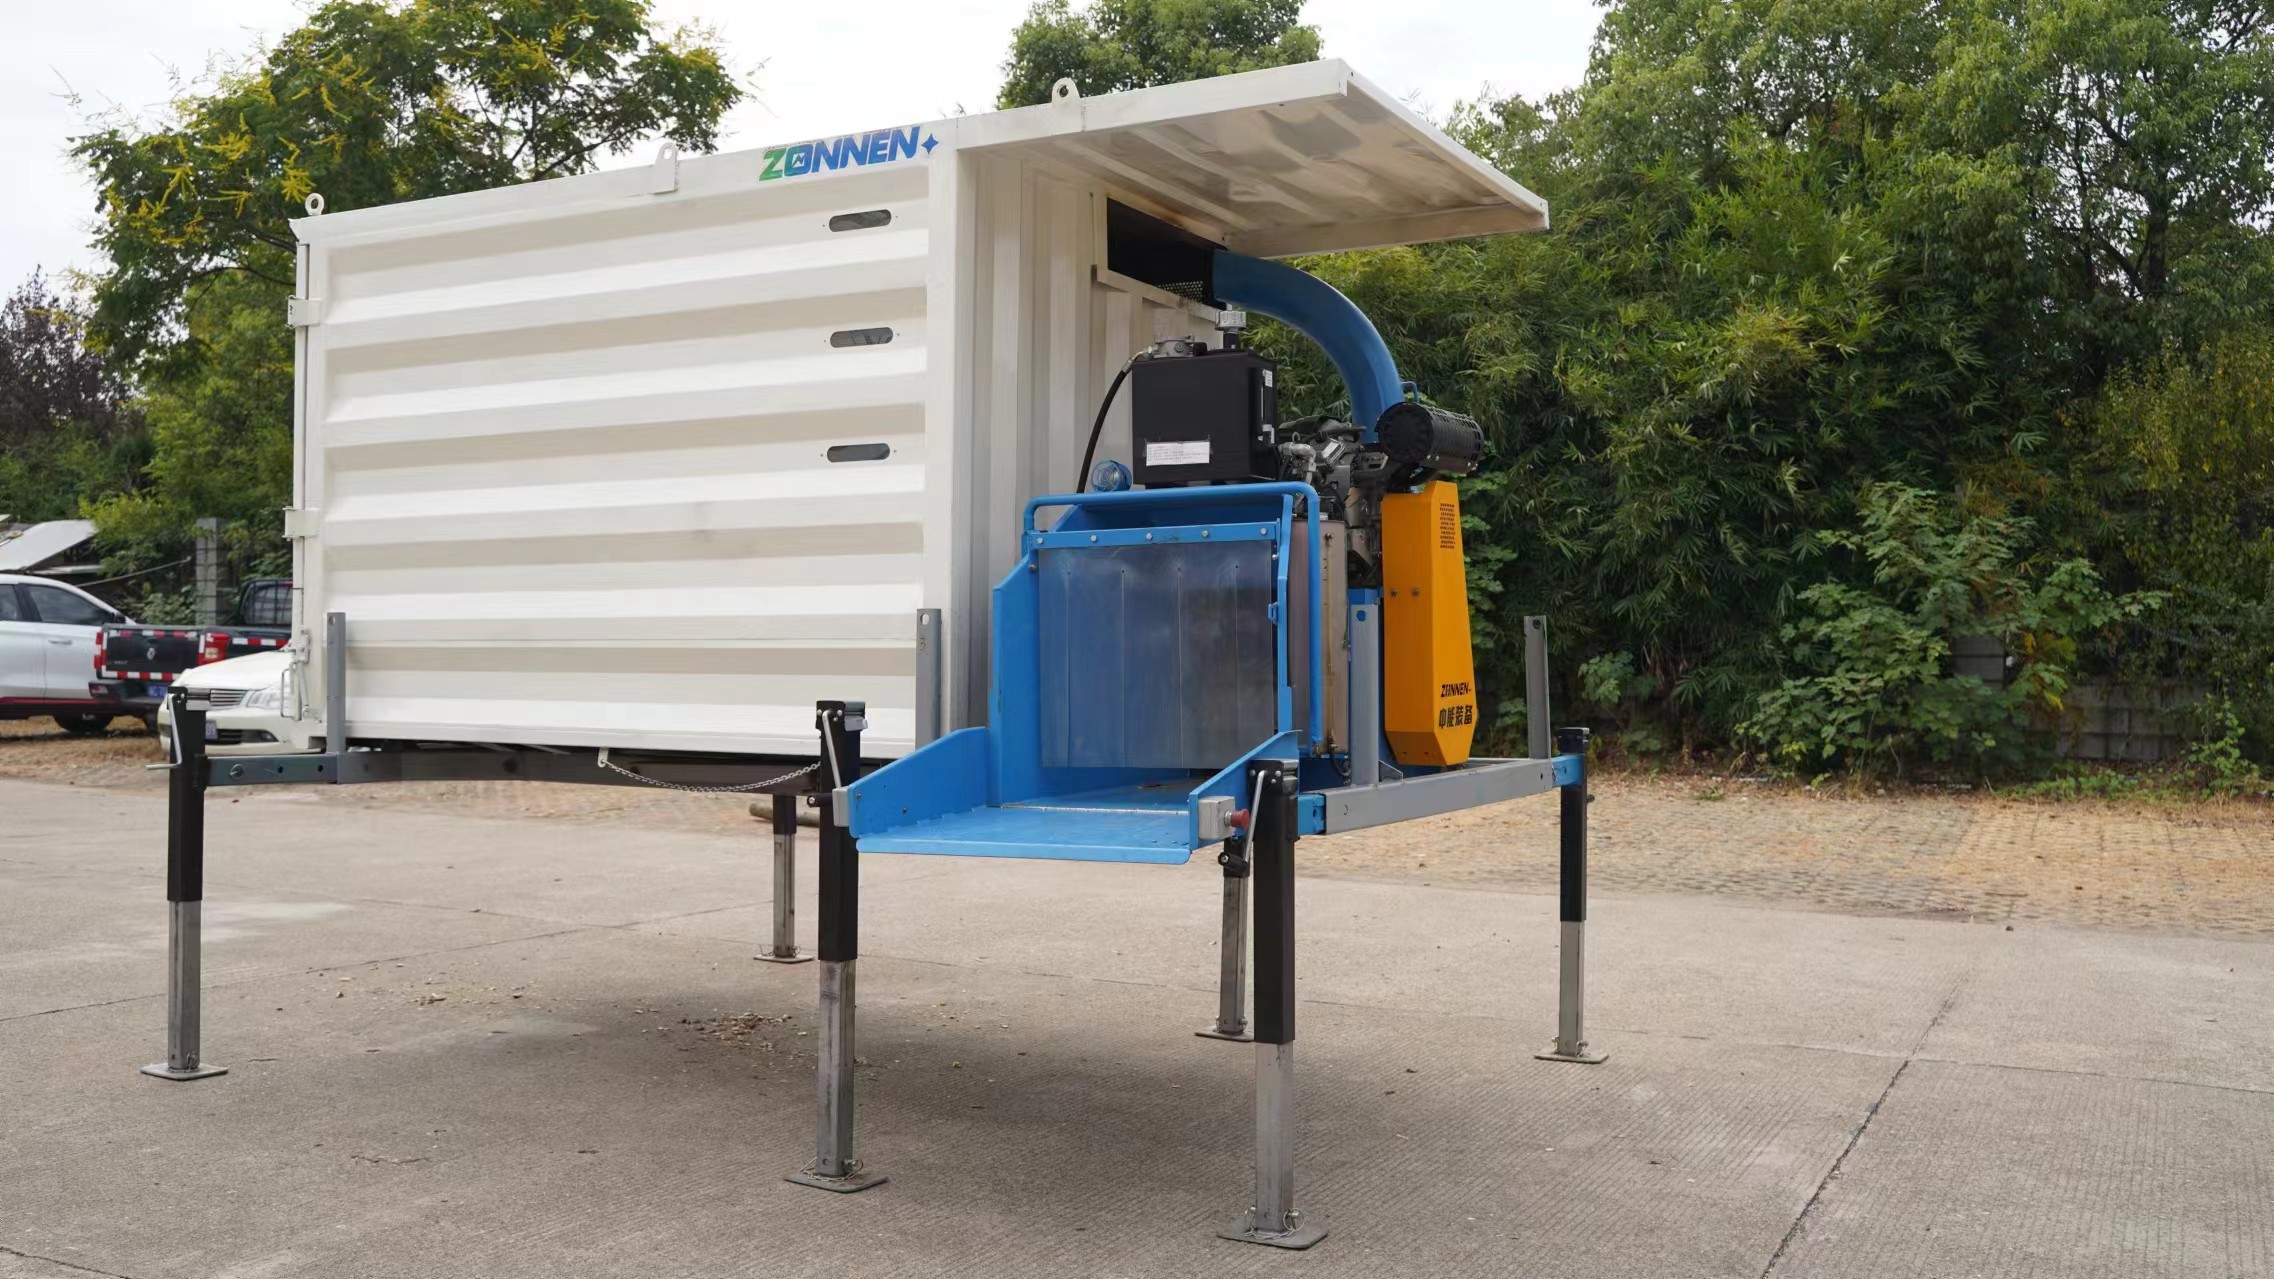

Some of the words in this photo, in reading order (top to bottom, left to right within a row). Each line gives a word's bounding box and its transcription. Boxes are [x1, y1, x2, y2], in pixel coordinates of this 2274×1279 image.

[758, 126, 921, 181] ZONNEN
[1438, 704, 1473, 728] 中能装备
